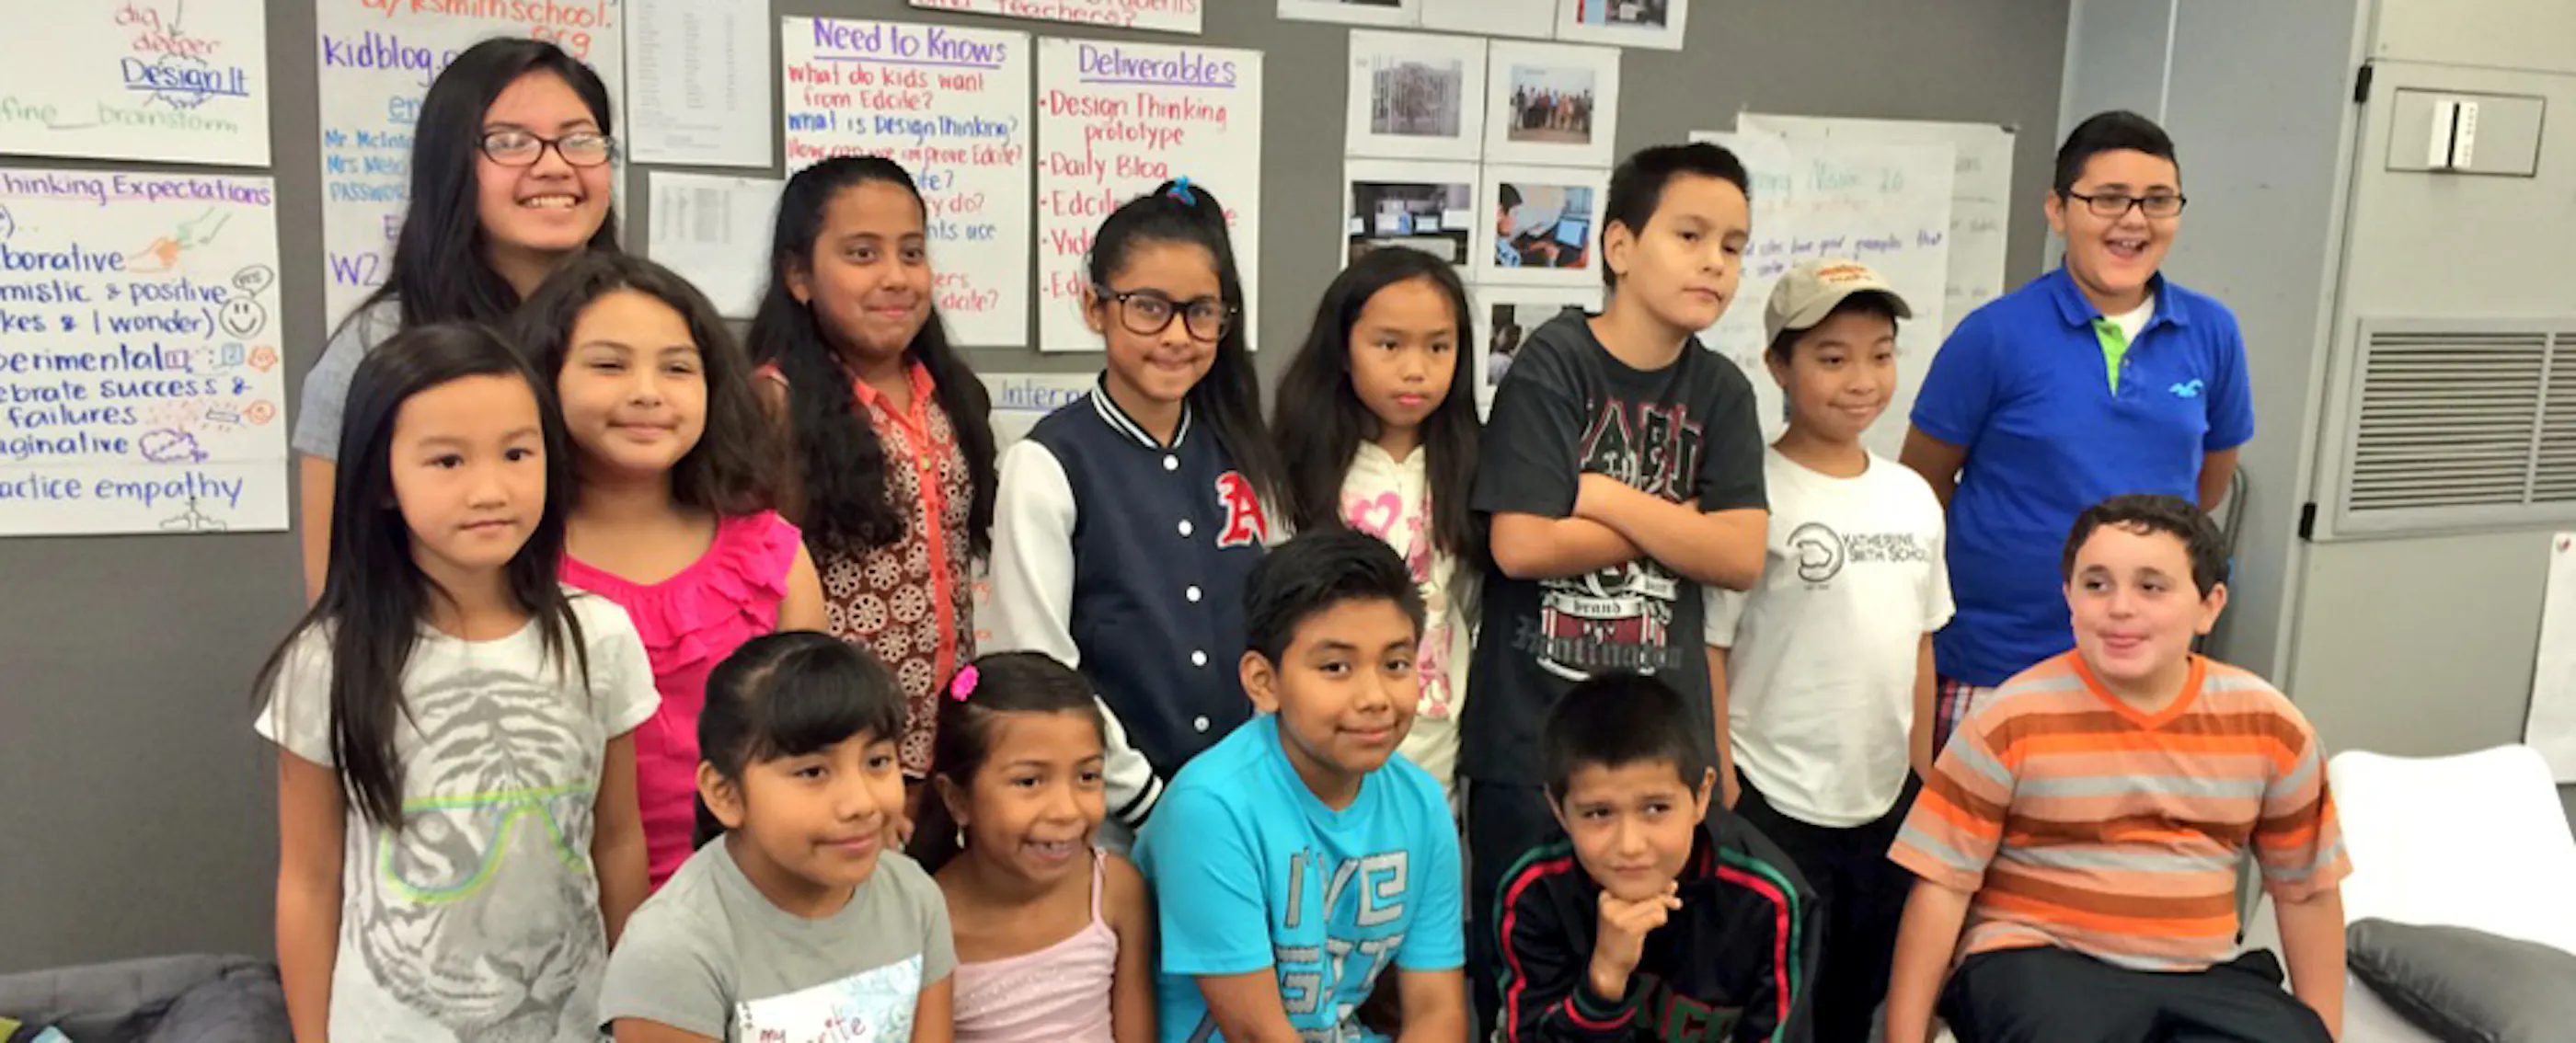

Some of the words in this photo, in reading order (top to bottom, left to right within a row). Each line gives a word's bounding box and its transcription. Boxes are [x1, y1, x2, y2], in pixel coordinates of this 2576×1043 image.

[813, 16, 880, 52] Need
[926, 27, 1006, 63] Knows
[121, 56, 221, 90] Design
[849, 63, 875, 86] do
[1079, 44, 1236, 84] Deliverables
[0, 96, 57, 122] fine
[1050, 89, 1128, 123] Design
[1138, 92, 1226, 132] Thinking
[1085, 120, 1184, 151] prototype
[3, 171, 108, 207] hinking
[113, 173, 272, 206] Expectations
[0, 242, 127, 273] borative
[99, 379, 217, 399] success
[8, 403, 138, 430] failures
[95, 471, 243, 509] empathy
[1214, 470, 1269, 550] A
